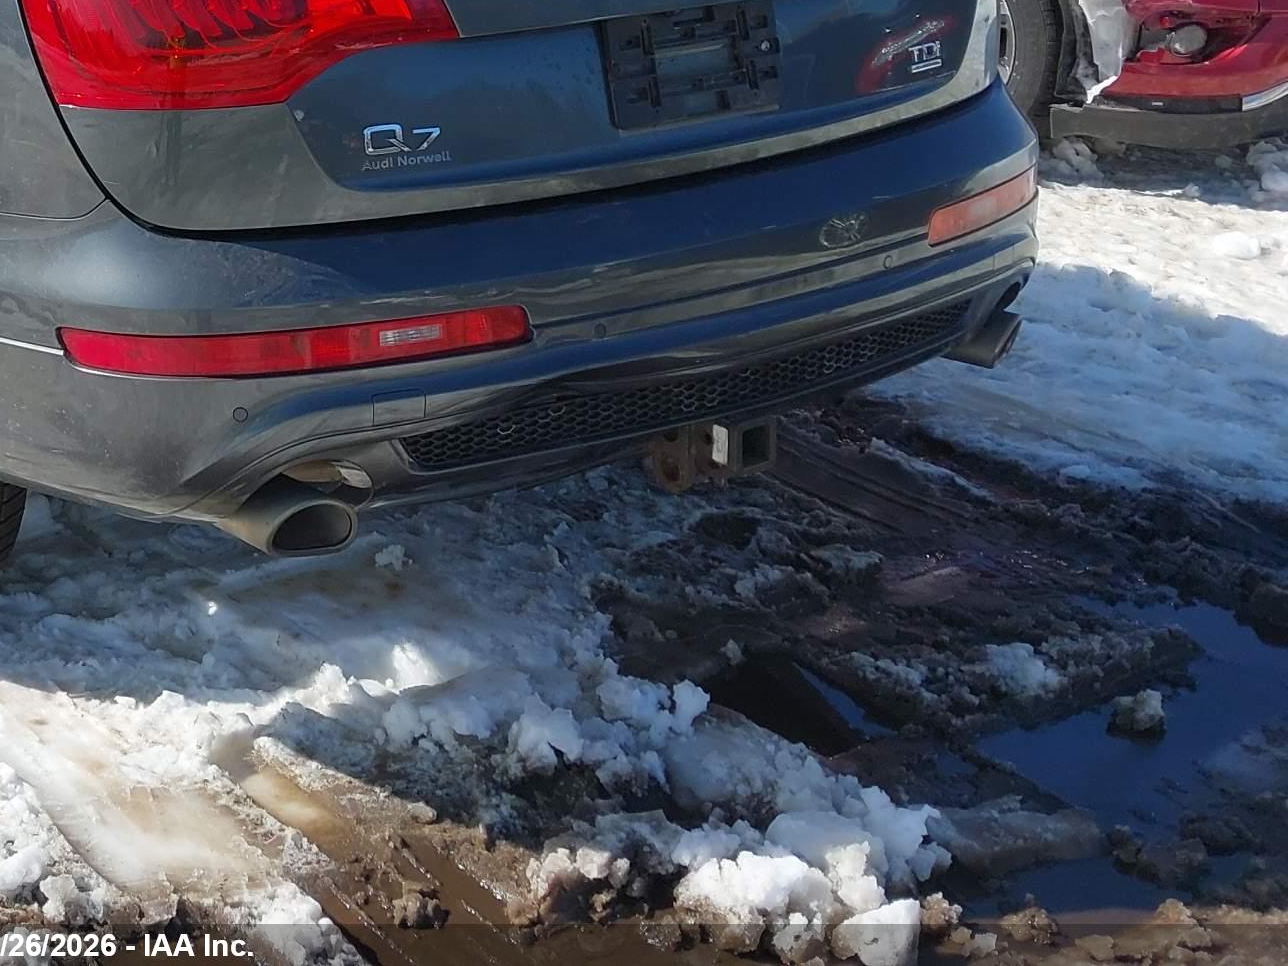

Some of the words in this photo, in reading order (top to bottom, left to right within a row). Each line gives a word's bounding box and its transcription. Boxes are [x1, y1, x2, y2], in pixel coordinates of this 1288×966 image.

[363, 123, 441, 156] Q7
[362, 153, 394, 171] Audi
[397, 150, 451, 167] Norwell
